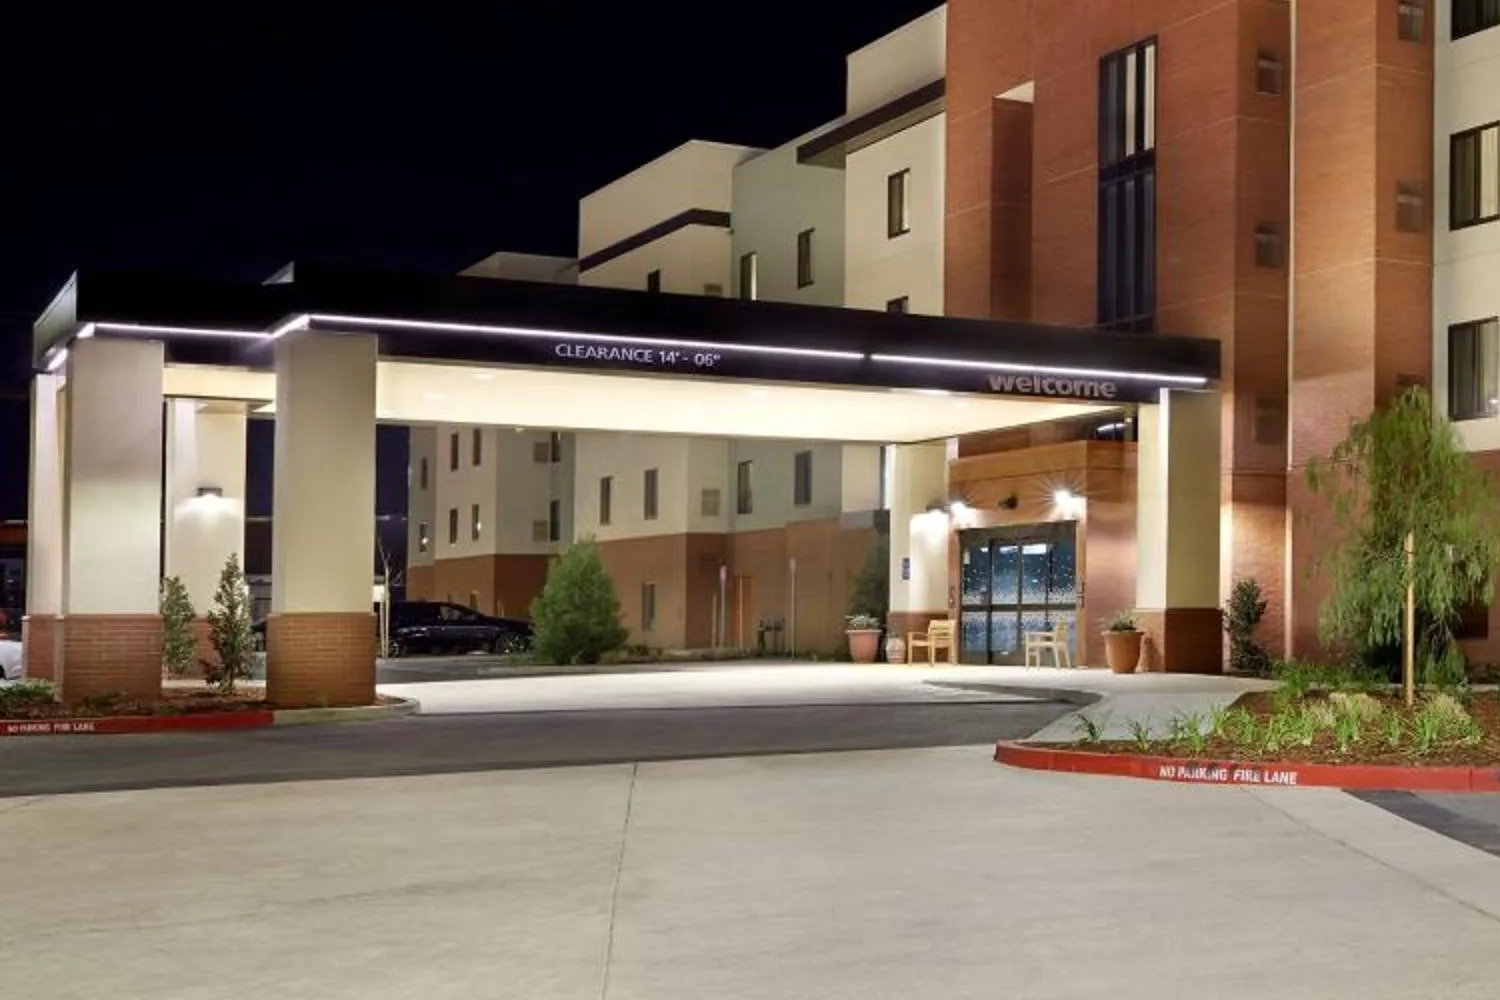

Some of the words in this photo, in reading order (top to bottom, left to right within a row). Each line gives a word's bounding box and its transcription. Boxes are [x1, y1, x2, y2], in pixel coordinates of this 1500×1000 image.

[555, 343, 653, 363] CLEARANCE
[988, 373, 1118, 398] welcome
[1159, 765, 1175, 777] NO
[1233, 769, 1261, 782] FIRE
[1264, 771, 1298, 785] LANE
